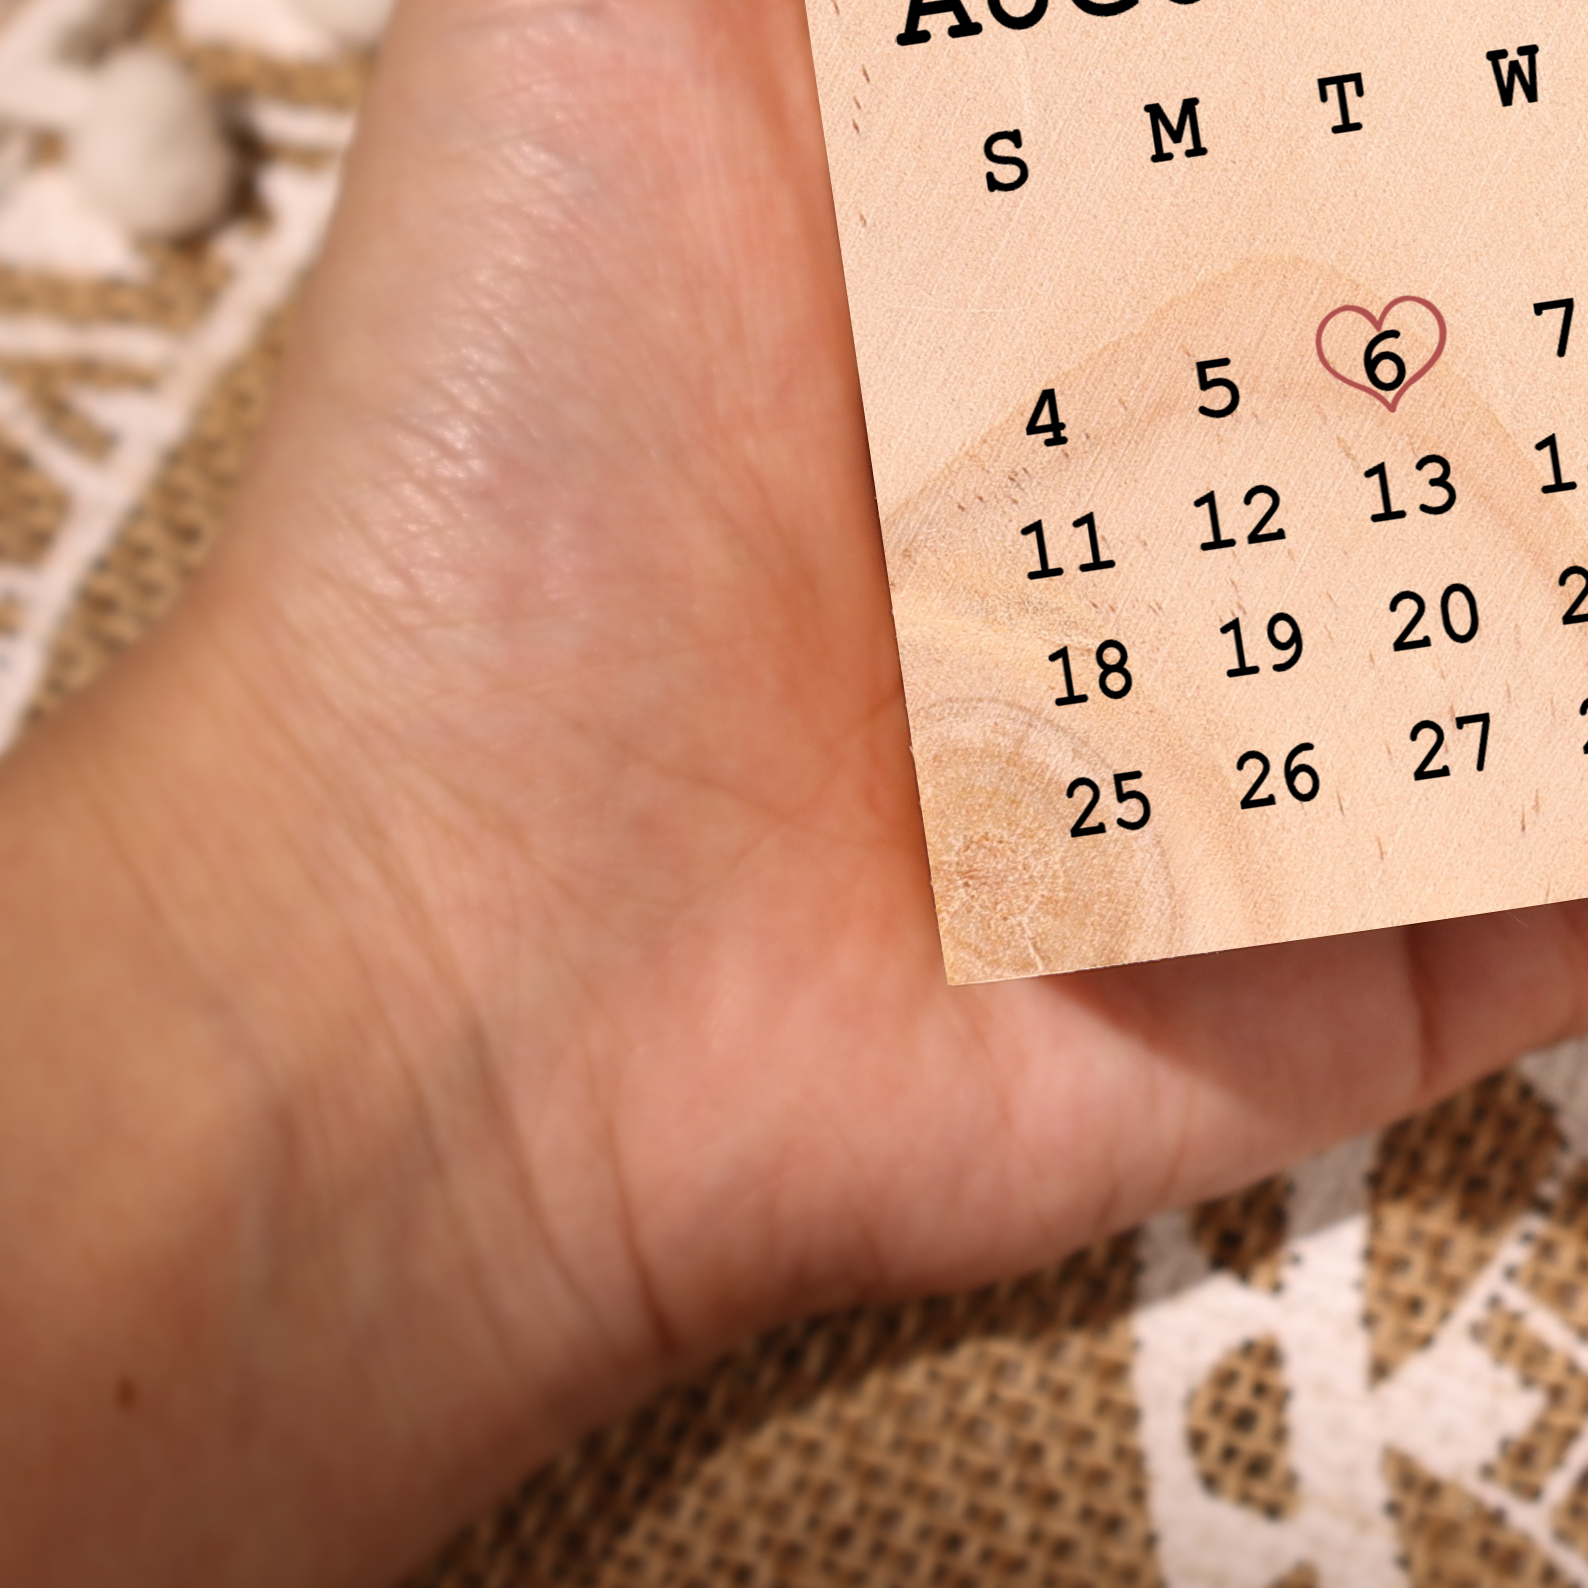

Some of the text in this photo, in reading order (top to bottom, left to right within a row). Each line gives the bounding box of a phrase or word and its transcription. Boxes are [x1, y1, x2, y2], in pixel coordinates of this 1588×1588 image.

[981, 126, 1030, 194] S
[1141, 95, 1209, 164] M
[1315, 70, 1366, 135] T
[1483, 42, 1540, 108] W
[1023, 386, 1069, 448] 4
[1193, 355, 1241, 420] 5
[1361, 327, 1407, 393] 6
[1531, 295, 1576, 359] 7
[1018, 509, 1117, 582] 11
[1191, 482, 1287, 553] 12
[1361, 452, 1458, 524] 13
[1046, 637, 1134, 708] 18
[1217, 610, 1304, 679] 19
[1387, 581, 1480, 653] 20
[1064, 768, 1152, 839] 25
[1234, 740, 1321, 811] 26
[1407, 710, 1492, 782] 27
